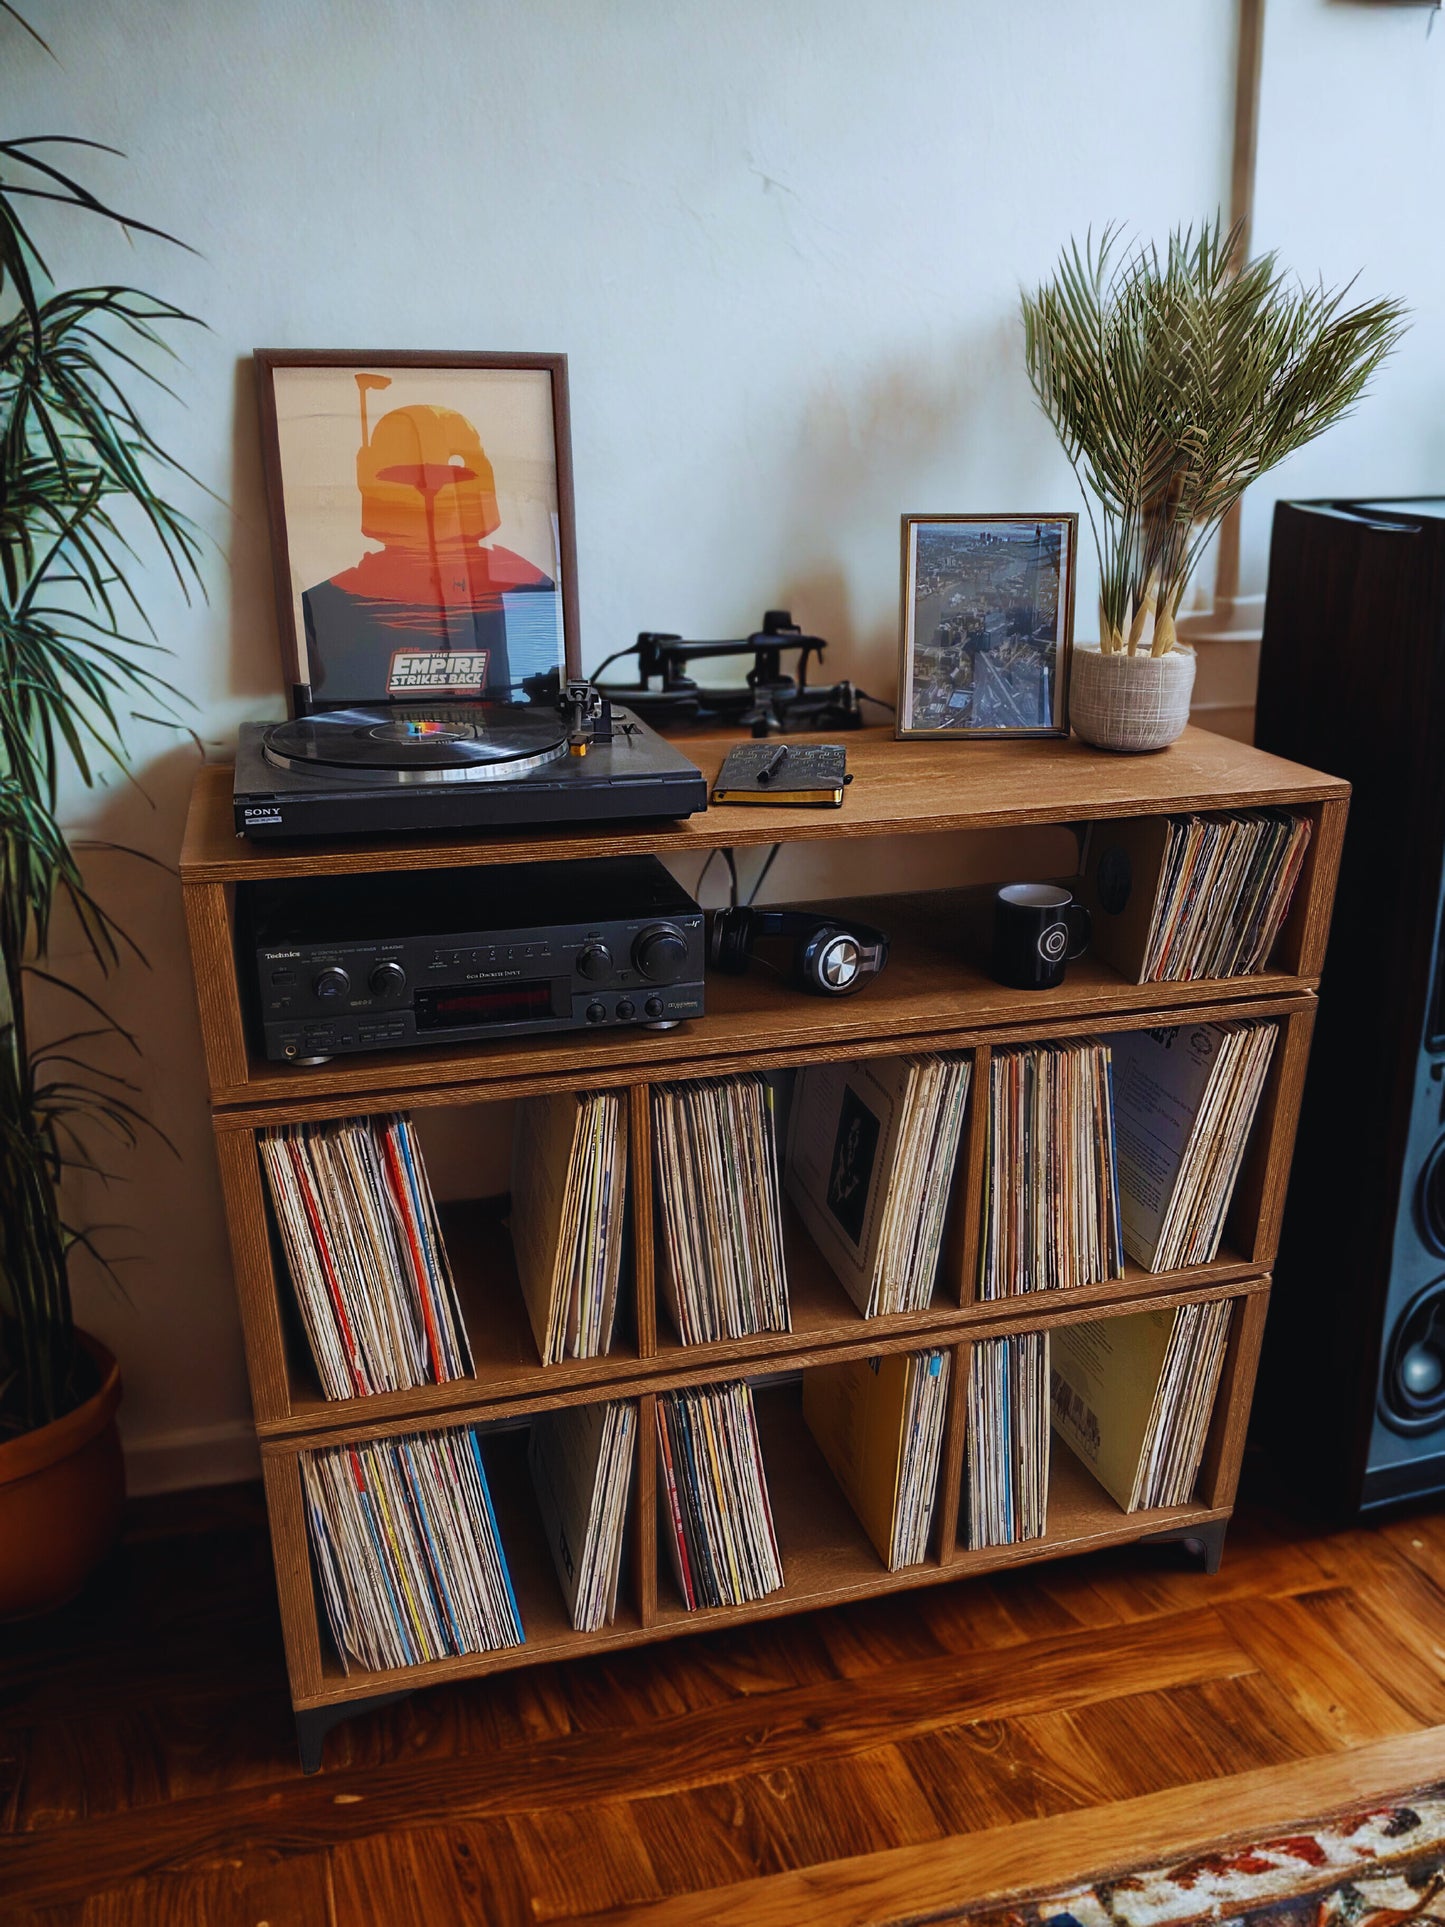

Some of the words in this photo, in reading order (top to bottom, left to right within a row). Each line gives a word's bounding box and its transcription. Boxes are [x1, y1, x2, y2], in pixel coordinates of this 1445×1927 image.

[392, 654, 486, 675] EMPIRE
[390, 674, 447, 685] STRIKES
[448, 673, 482, 684] BACK
[244, 808, 280, 816] SONY
[265, 951, 301, 960] Technics
